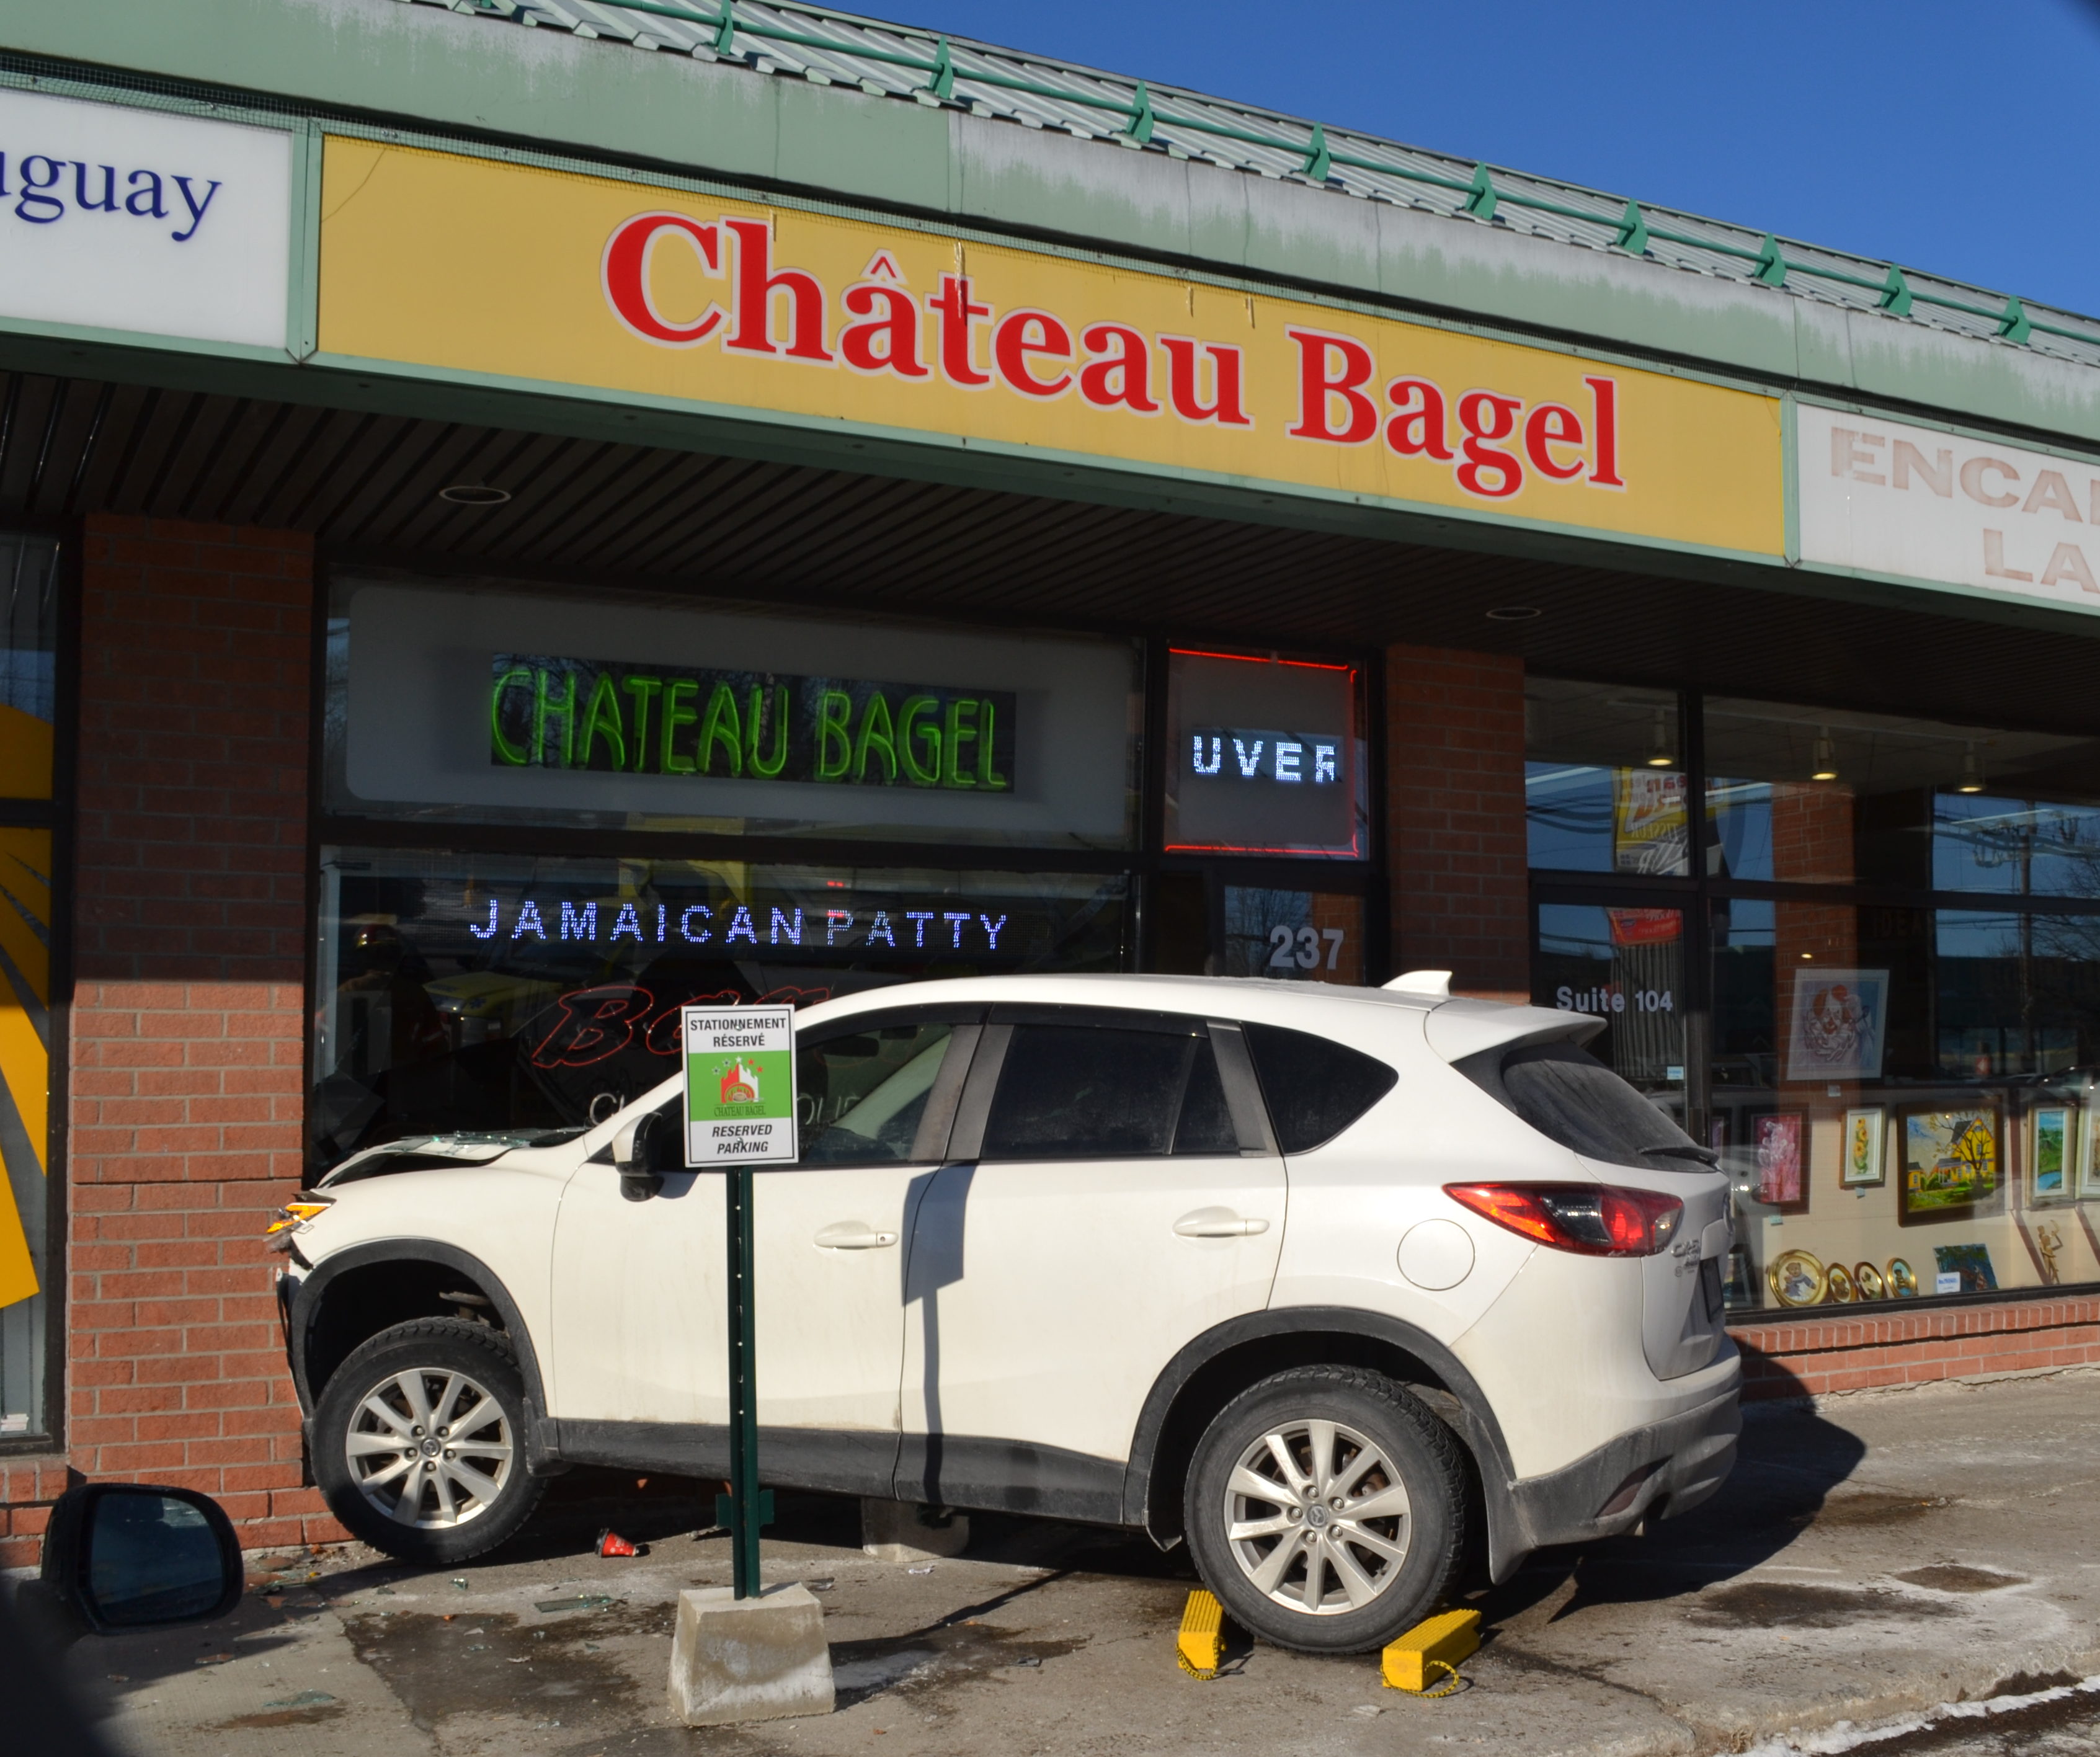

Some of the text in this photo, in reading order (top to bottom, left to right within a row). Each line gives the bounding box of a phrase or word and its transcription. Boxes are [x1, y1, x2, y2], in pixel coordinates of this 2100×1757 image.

[0, 151, 222, 242] guay
[605, 214, 1625, 497] Château Bagel
[494, 666, 1007, 789] CHATEAU BAGEL
[469, 899, 1008, 950] JAMAICAN PATTY
[1270, 925, 1344, 971] 237
[1556, 986, 1673, 1012] Suite 104
[690, 1018, 786, 1031] STATIONNEMENT
[713, 1033, 765, 1048] RÉSERVÉ
[745, 1105, 767, 1116] BAGEL
[712, 1124, 773, 1138] RESERVED
[717, 1141, 769, 1155] PARKING
